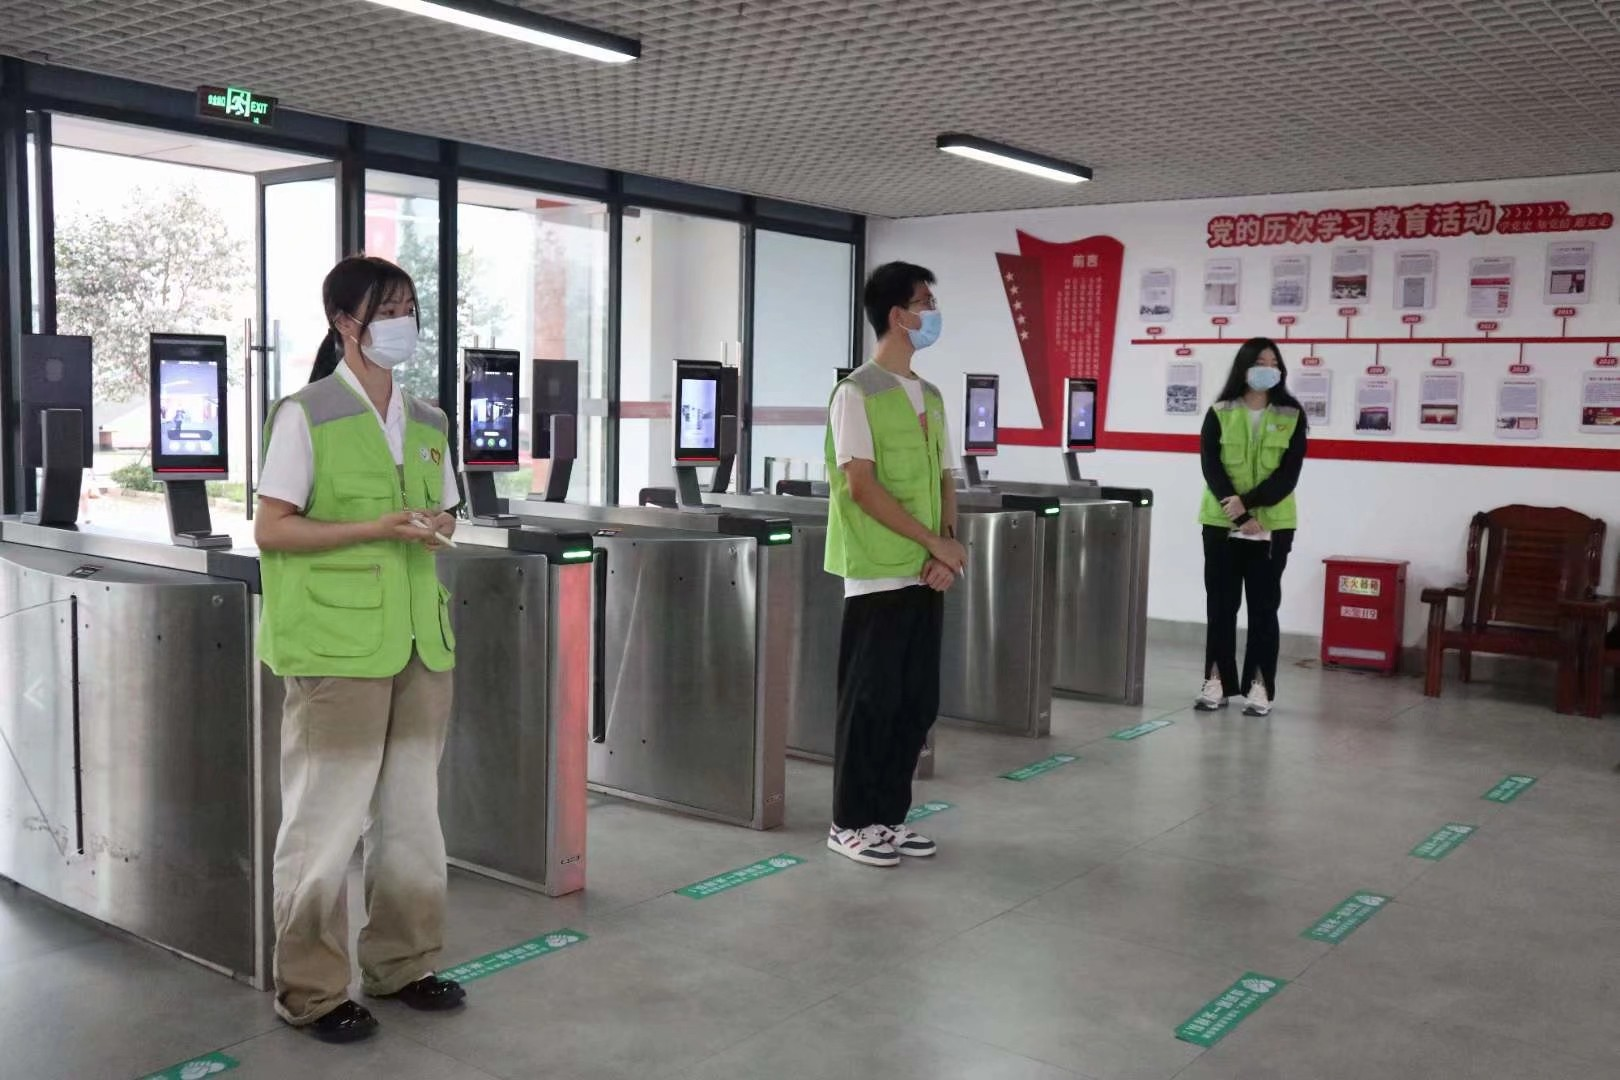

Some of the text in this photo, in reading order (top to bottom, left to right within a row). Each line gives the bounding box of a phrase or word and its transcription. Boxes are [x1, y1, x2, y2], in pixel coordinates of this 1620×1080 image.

[251, 101, 268, 114] EXIT
[1209, 204, 1492, 246] 党的历次学习教育活动
